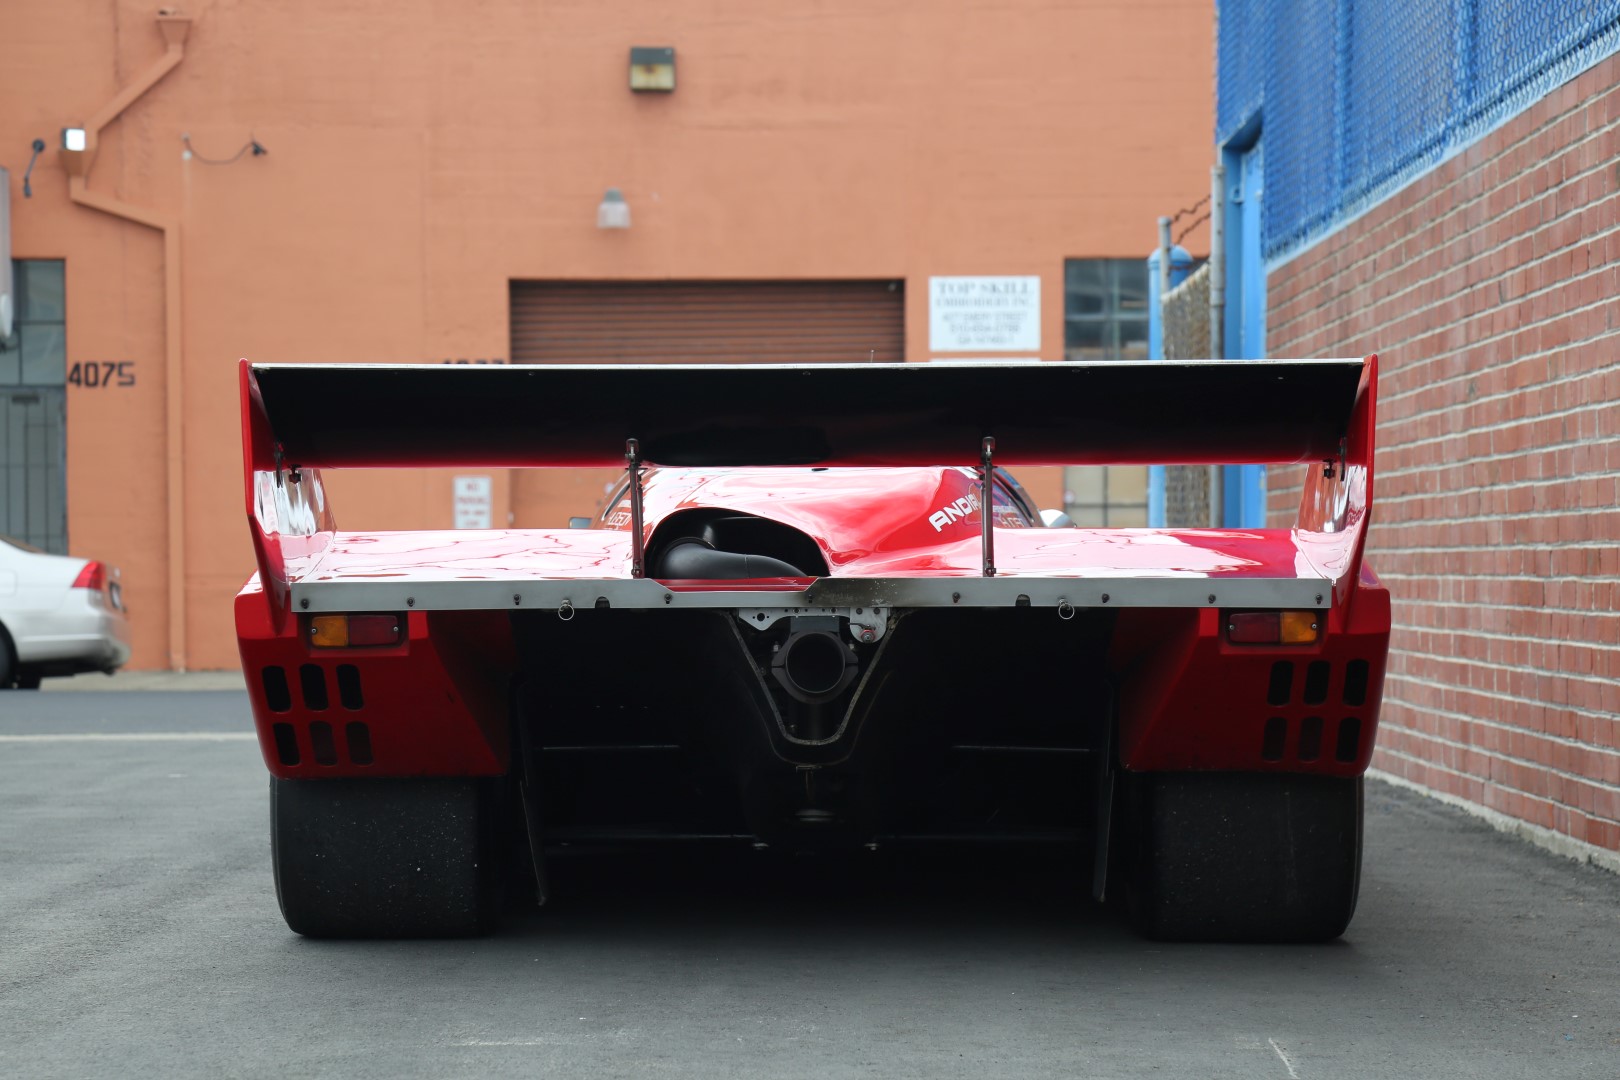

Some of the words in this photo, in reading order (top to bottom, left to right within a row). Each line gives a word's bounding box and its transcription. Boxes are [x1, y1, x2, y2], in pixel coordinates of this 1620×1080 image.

[938, 281, 976, 294] TOP
[980, 281, 1034, 294] SKILL
[68, 361, 136, 387] 4075
